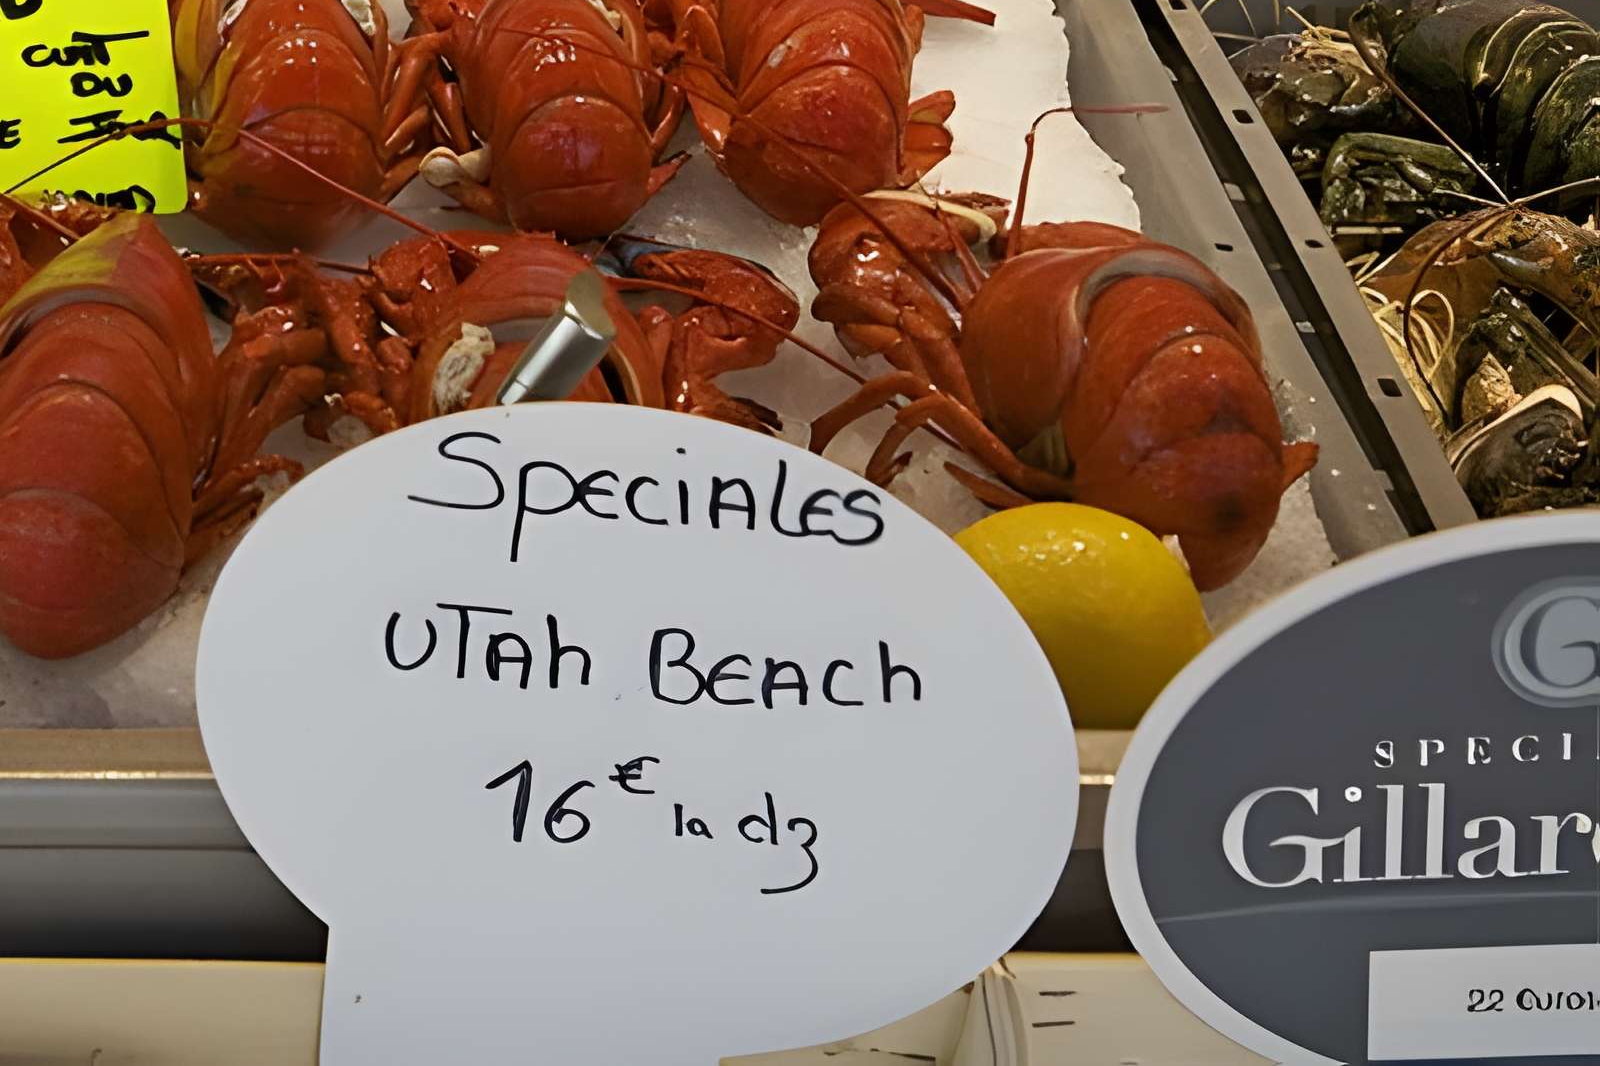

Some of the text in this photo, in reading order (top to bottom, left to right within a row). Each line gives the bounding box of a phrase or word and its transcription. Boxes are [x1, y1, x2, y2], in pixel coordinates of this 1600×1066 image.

[70, 71, 133, 97] DU
[1372, 731, 1600, 769] SPECI
[674, 802, 714, 840] la
[1221, 781, 1600, 889] Gillar
[1467, 988, 1505, 1013] 22
